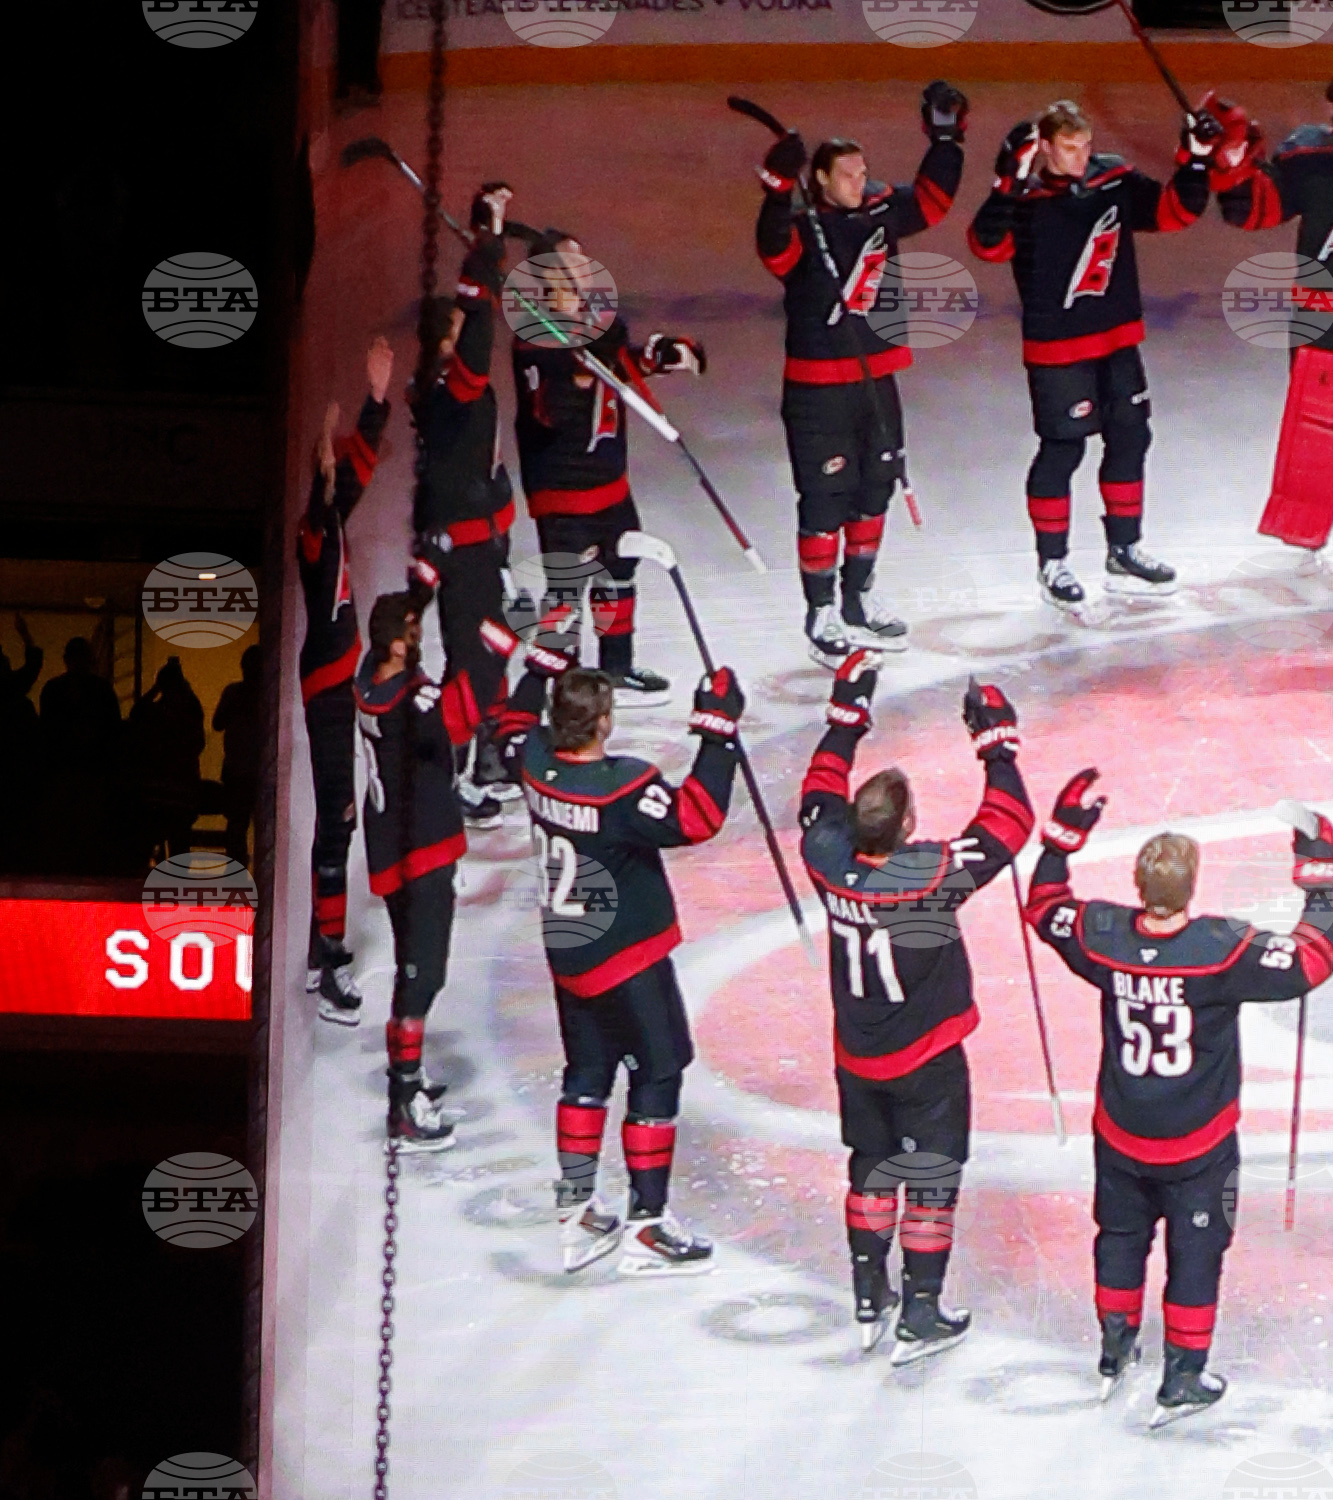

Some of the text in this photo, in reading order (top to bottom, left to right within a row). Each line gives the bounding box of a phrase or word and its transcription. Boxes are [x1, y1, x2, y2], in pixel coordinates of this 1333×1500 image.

[834, 919, 906, 1004] 71
[1113, 974, 1186, 1006] BLAKE
[1117, 1000, 1195, 1078] 53
